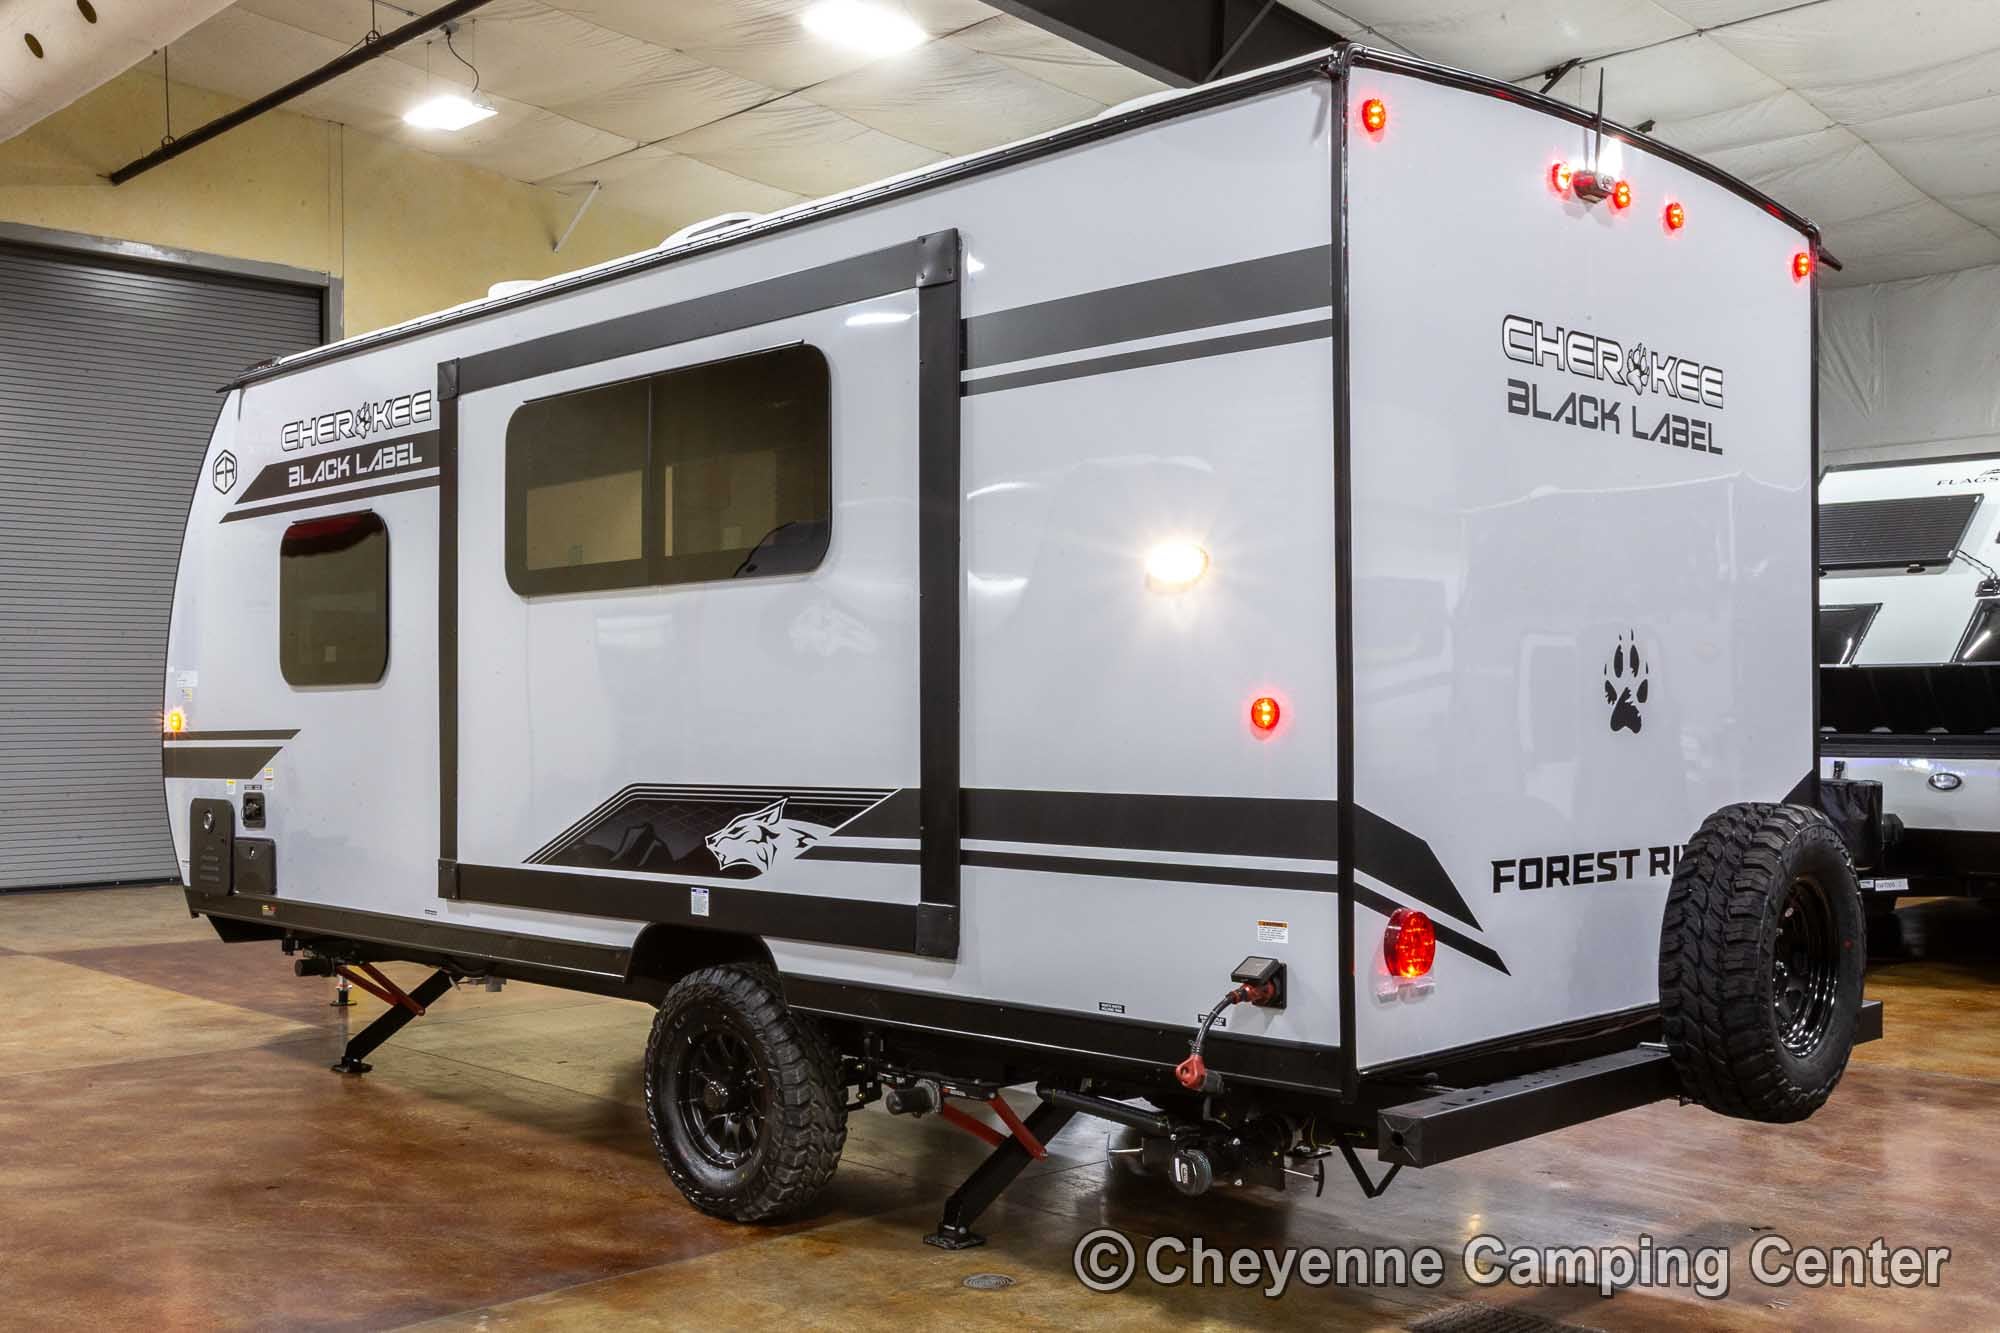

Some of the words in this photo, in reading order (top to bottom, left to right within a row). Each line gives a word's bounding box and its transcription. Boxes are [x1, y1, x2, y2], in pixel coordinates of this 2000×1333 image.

[1508, 378, 1621, 434] BLACK
[1632, 405, 1723, 455] LABEL
[289, 455, 351, 487] BLACK
[356, 442, 422, 474] LABEL
[1491, 848, 1641, 893] FOREST
